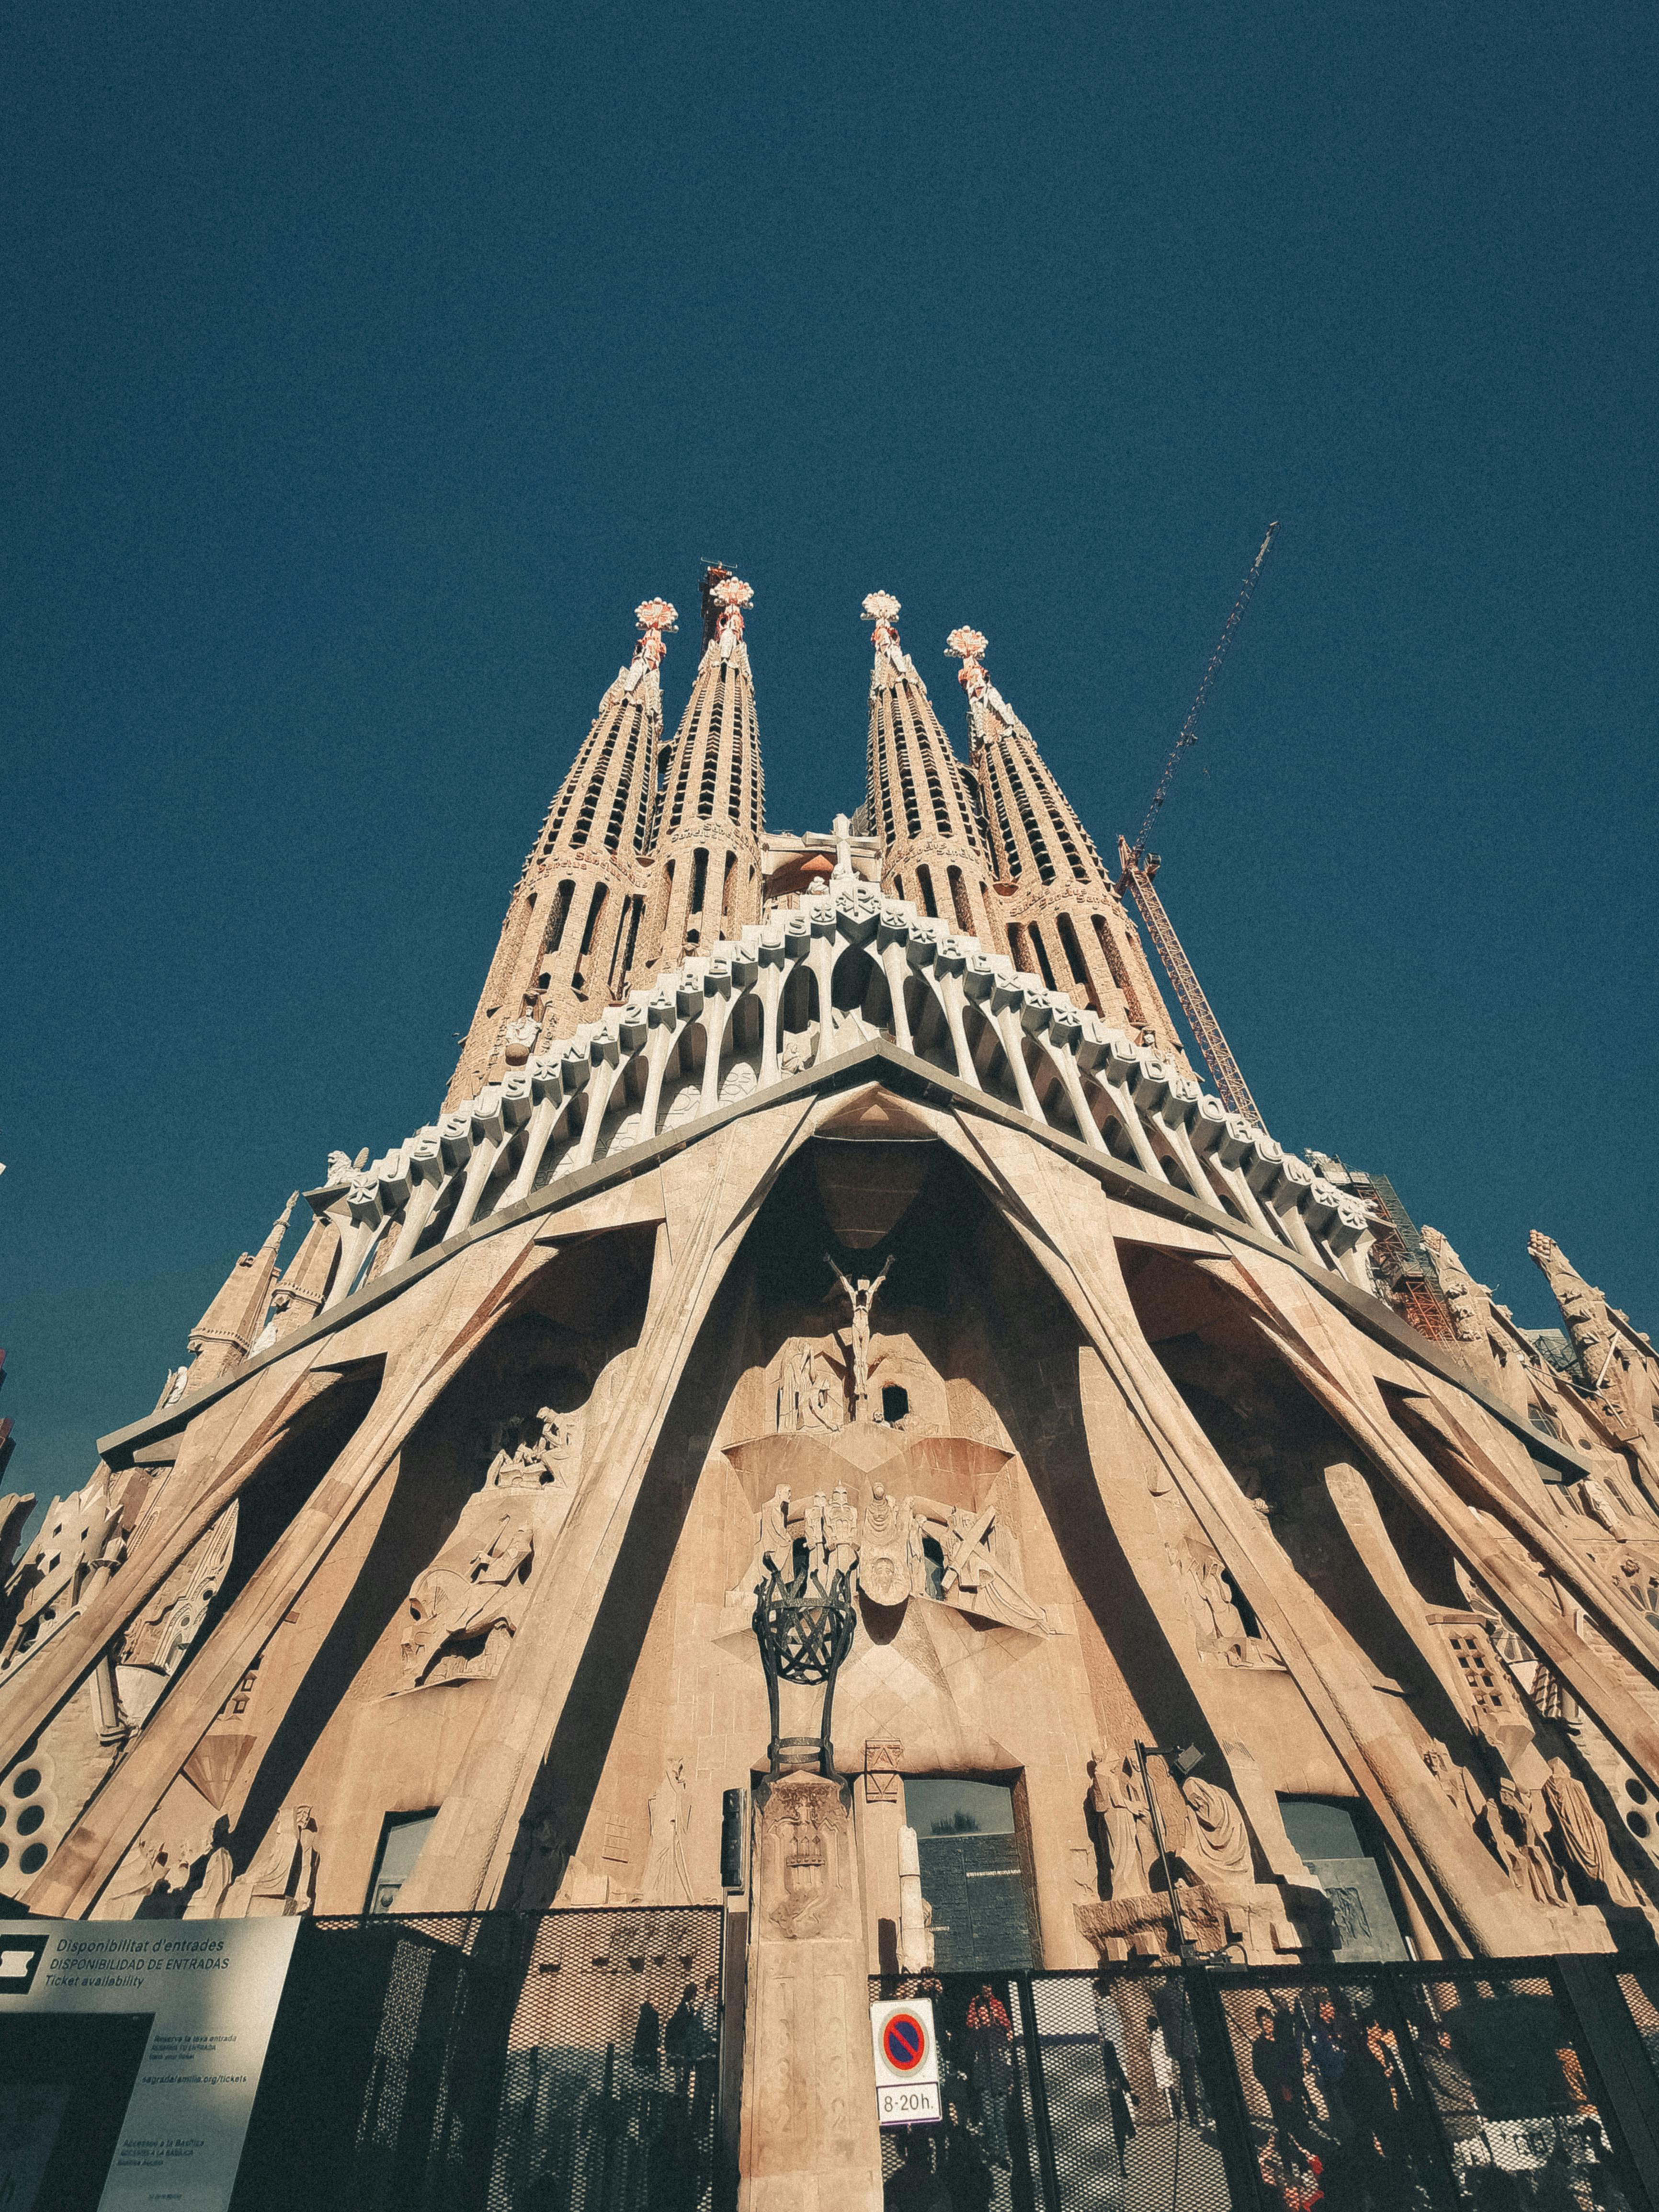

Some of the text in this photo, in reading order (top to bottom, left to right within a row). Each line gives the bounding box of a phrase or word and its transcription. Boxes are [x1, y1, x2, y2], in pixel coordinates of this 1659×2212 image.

[56, 1938, 224, 1955] Disponibilitat d'entrades
[50, 1958, 230, 1970] DISPONIBILIDAD DE ENTRADAS
[45, 1975, 144, 1989] Ticket availability
